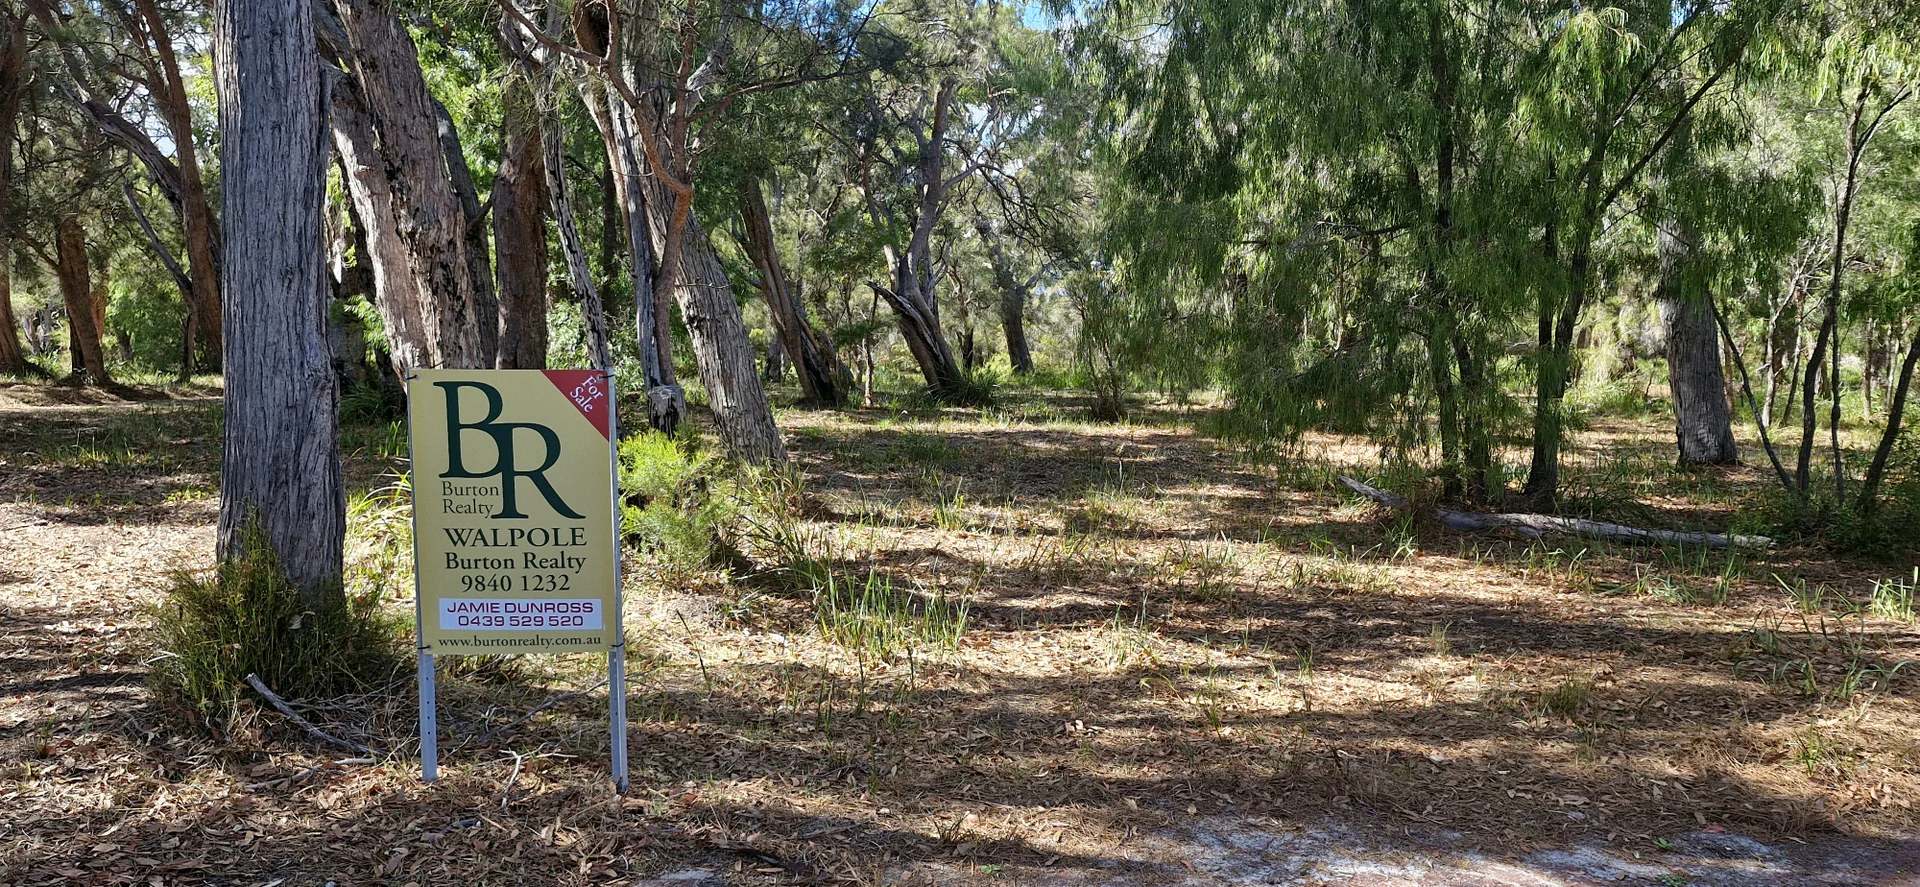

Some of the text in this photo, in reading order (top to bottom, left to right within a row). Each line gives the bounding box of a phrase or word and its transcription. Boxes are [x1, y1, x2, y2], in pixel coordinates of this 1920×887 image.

[581, 375, 603, 399] For
[569, 386, 593, 412] Sale
[441, 481, 499, 496] Burton
[442, 498, 494, 518] Realty
[443, 527, 587, 547] WALPOLE
[445, 551, 587, 574] Burton Realty
[461, 574, 570, 593] 9840 1232
[447, 602, 594, 613] JAMIE DUNROSS
[458, 615, 583, 627] 0439 529 520
[438, 634, 601, 649] www.burtonrealty.com.au
